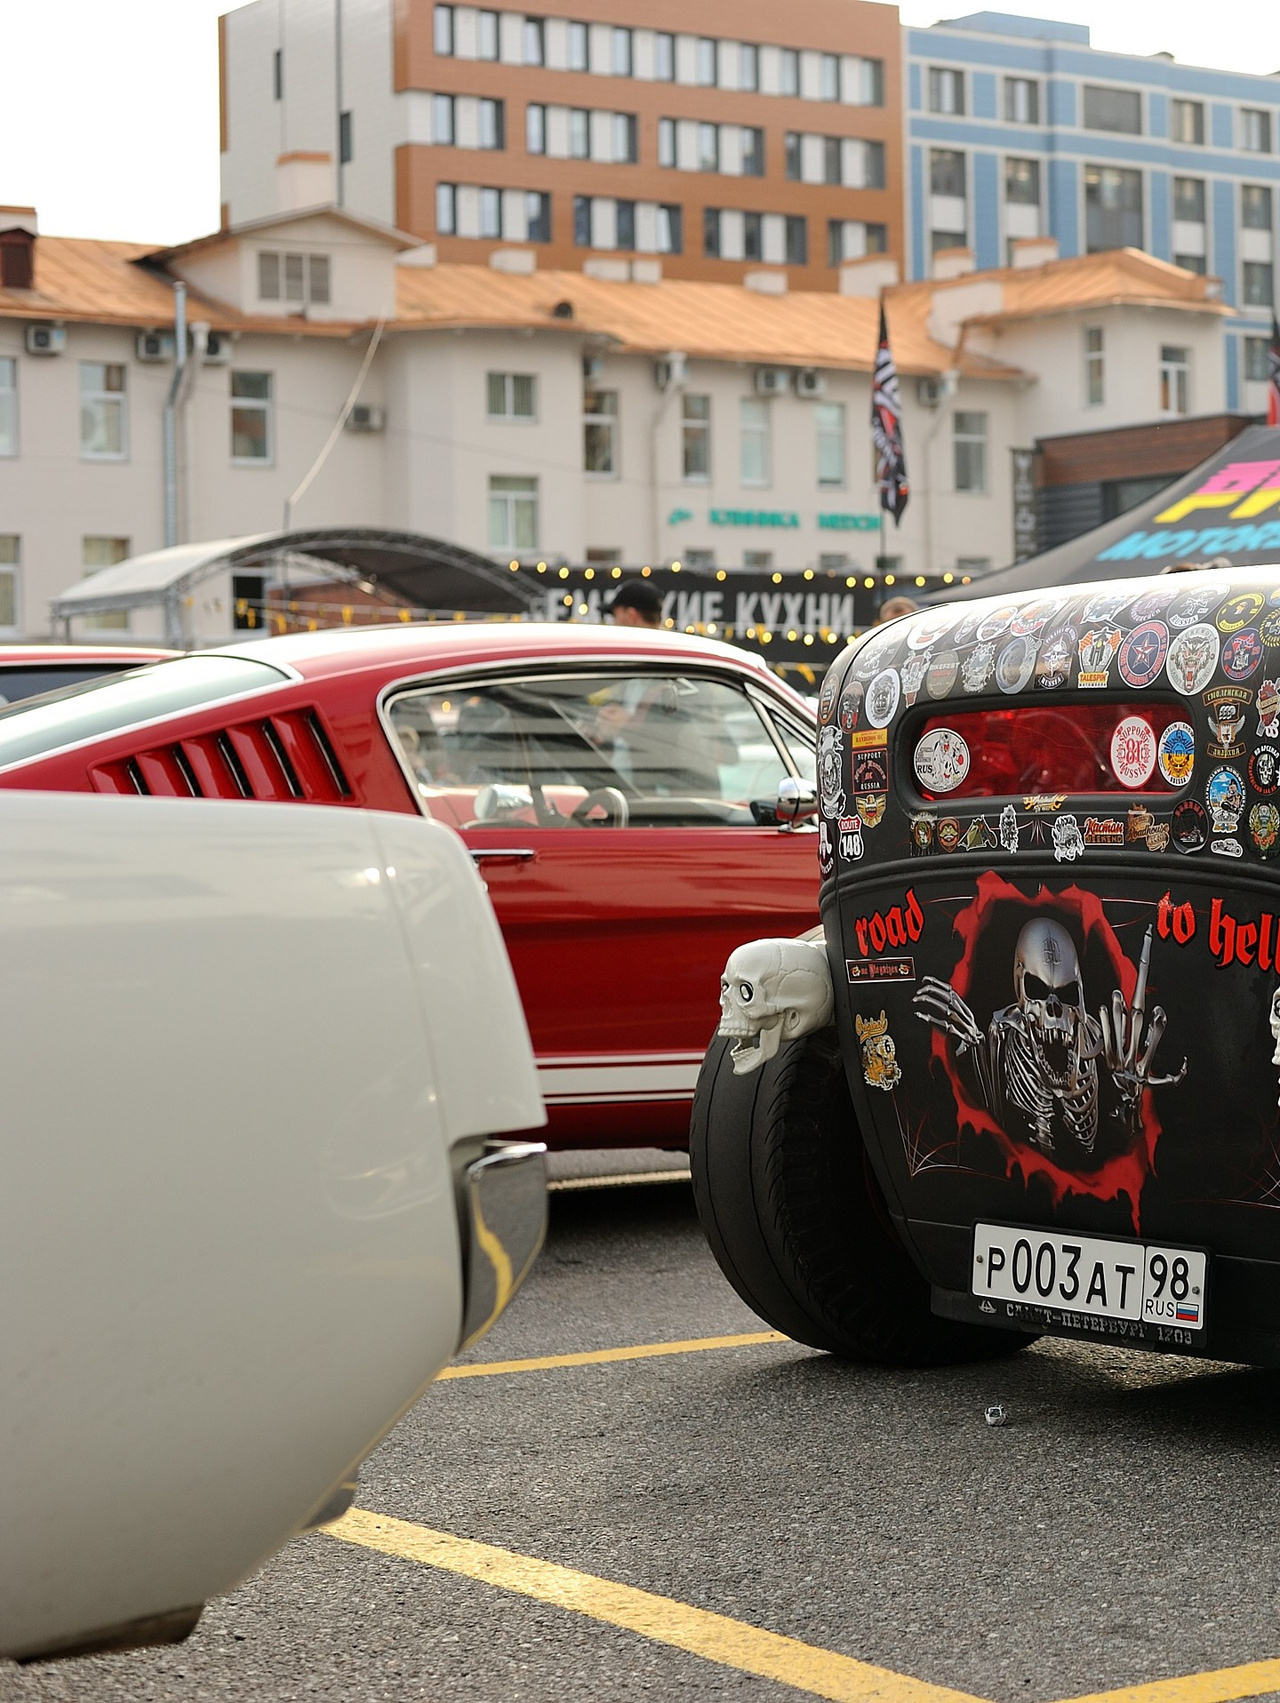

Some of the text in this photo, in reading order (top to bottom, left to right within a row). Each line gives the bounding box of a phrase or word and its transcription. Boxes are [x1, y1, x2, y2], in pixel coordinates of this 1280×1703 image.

[735, 590, 855, 640] КУХНИ
[1170, 615, 1197, 626] RUSSIA
[1041, 676, 1062, 687] RUSSIA
[1079, 673, 1107, 682] TALESPIN
[1119, 726, 1149, 744] SUPPORT
[857, 751, 882, 760] SUPPORT
[1126, 738, 1142, 765] 81
[917, 764, 933, 774] RUS
[1119, 762, 1147, 778] RUSSIA
[861, 782, 880, 790] RUSSIA
[840, 820, 859, 831] ROUTE
[854, 888, 924, 957] road
[1157, 888, 1196, 944] to
[855, 1009, 888, 1040] Original
[884, 1039, 892, 1053] 6
[1149, 1253, 1190, 1301] 98
[1145, 1298, 1175, 1318] RUS
[1157, 1326, 1193, 1345] 1703
